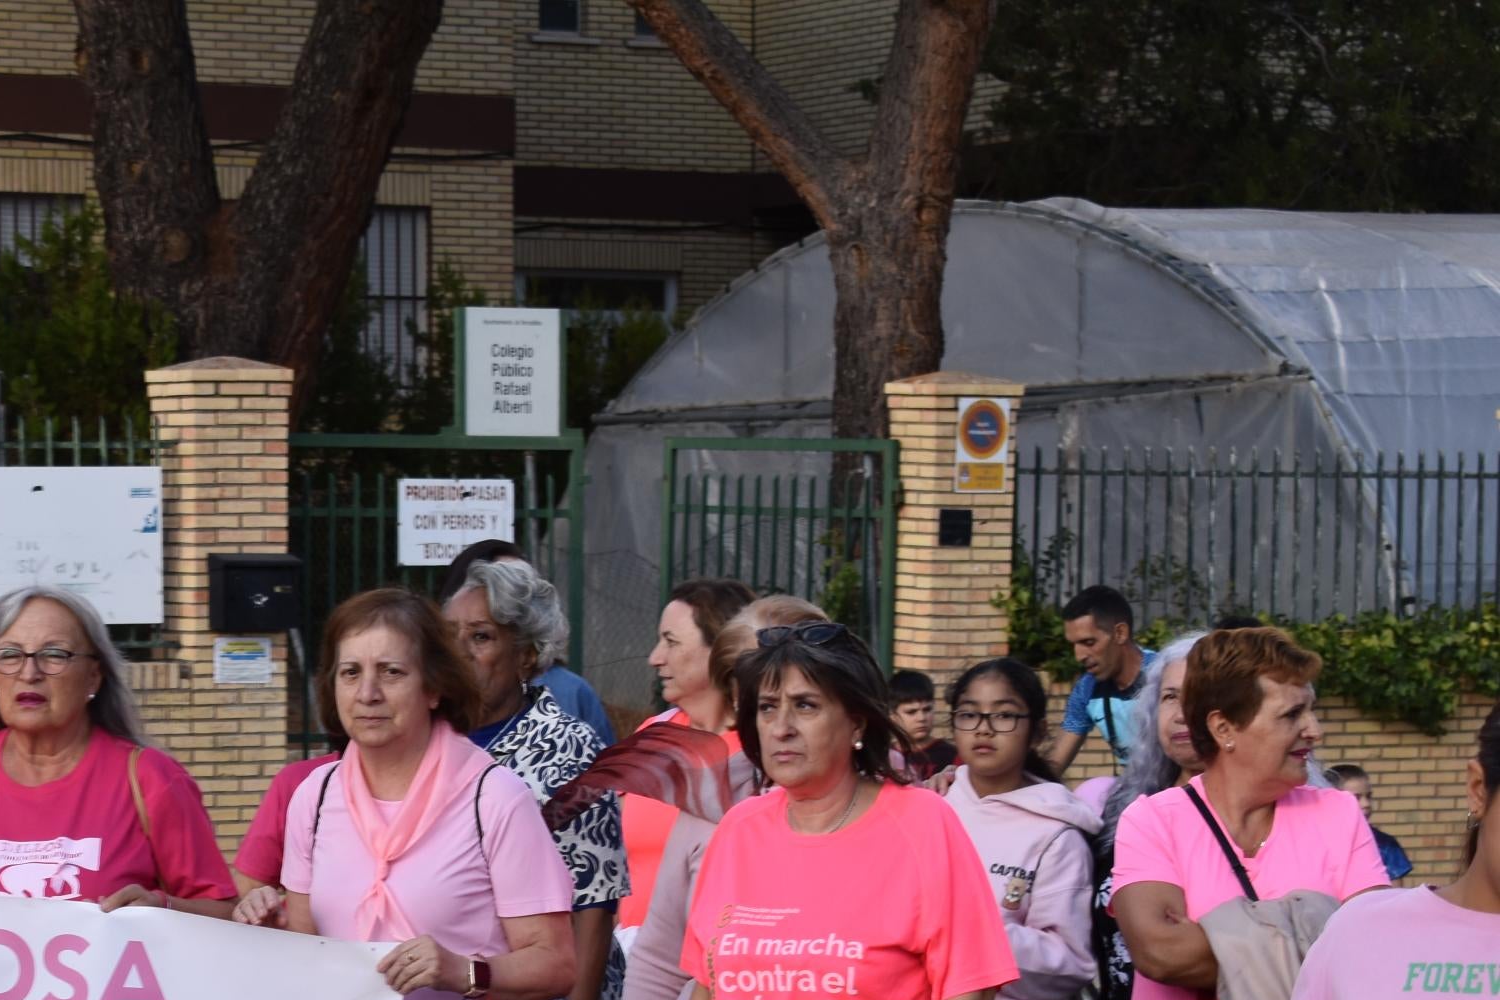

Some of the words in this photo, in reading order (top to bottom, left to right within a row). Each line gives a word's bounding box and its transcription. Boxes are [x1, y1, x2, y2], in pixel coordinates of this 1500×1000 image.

[491, 344, 534, 360] Colegio
[491, 362, 534, 377] Público
[493, 381, 531, 396] Rafael
[492, 400, 532, 414] Alberti
[404, 485, 465, 501] PROHIBIDO
[472, 485, 507, 501] PASAR
[413, 514, 438, 530] CON
[442, 514, 486, 530] PERROS
[489, 514, 499, 530] Y
[717, 932, 750, 956] En
[755, 932, 865, 960] marcha
[717, 963, 818, 994] contra
[821, 966, 859, 995] el
